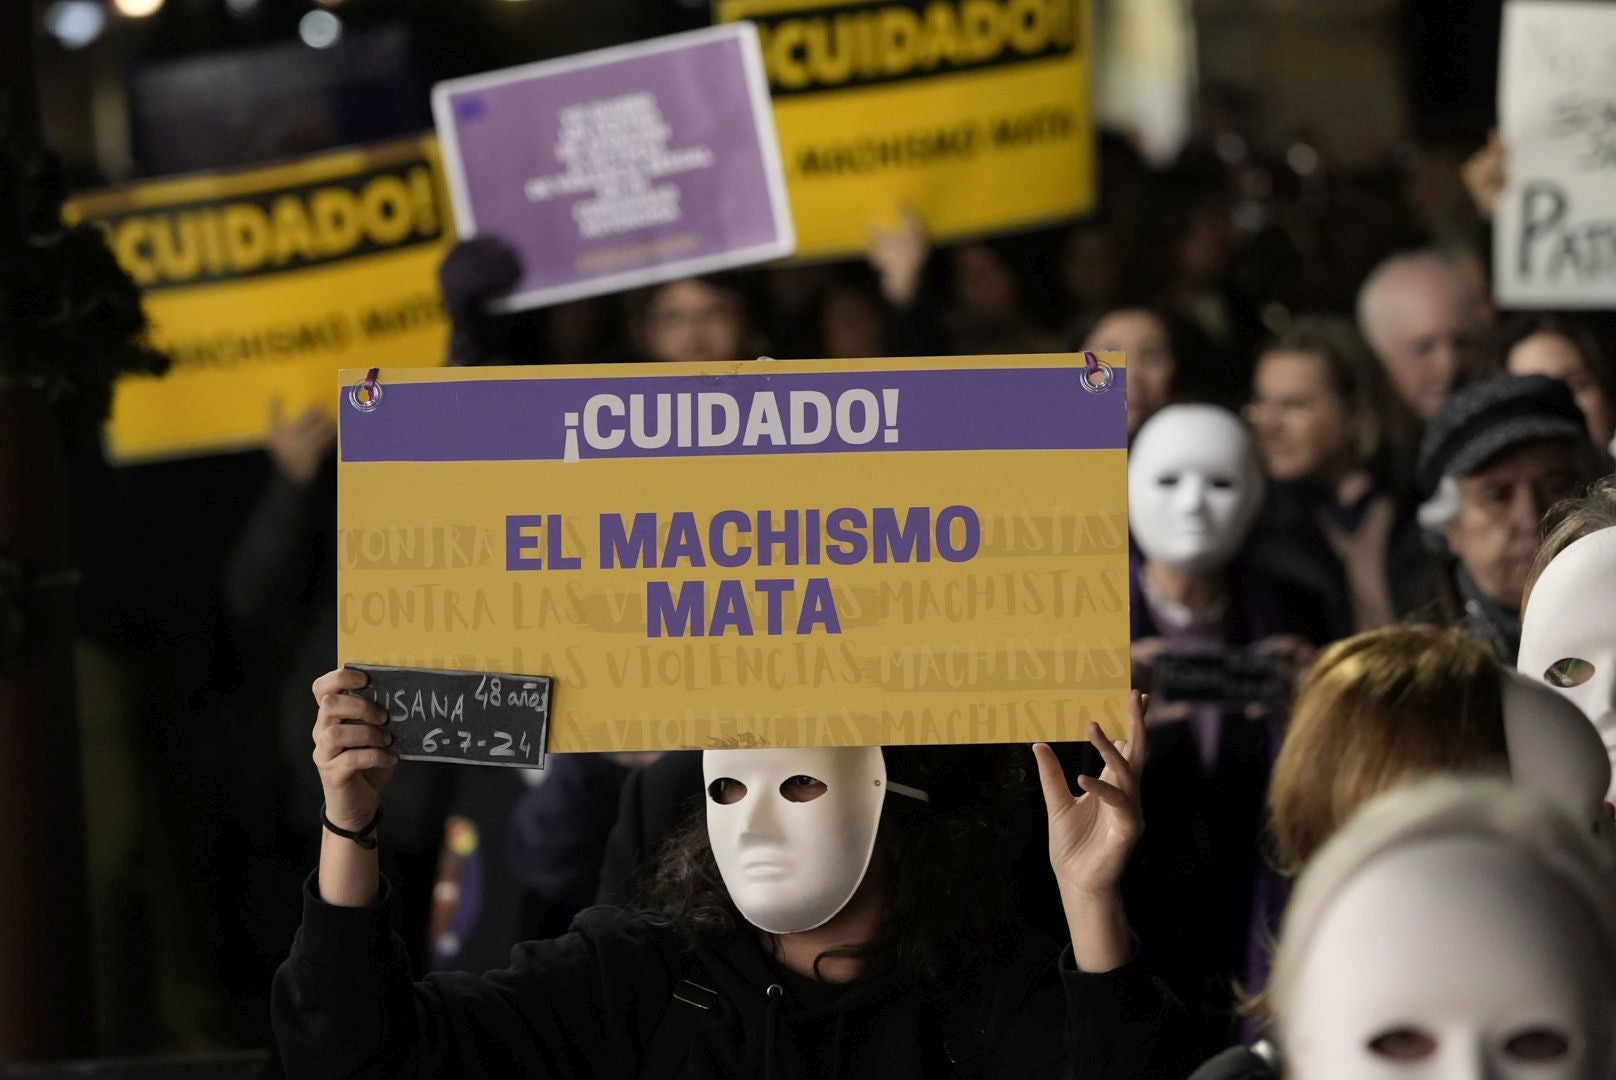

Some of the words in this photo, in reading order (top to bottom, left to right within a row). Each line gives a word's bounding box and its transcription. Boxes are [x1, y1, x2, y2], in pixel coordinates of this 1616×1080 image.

[760, 0, 1073, 89] CUIDADO!
[110, 168, 434, 285] CUIDADO!
[1515, 178, 1616, 283] PAT
[563, 388, 900, 463] ¡CUIDADO!
[340, 518, 496, 570] CONTRA
[505, 514, 581, 571] EL
[598, 504, 981, 570] MACHISMO
[339, 582, 497, 635] CONTRA
[512, 580, 588, 631] LAS
[880, 568, 1124, 624] MACHISTAS
[646, 577, 842, 638] MATA
[605, 638, 863, 692] VIOLENCIAS
[880, 634, 1125, 690] MACHISTAS
[372, 685, 464, 723] SANA
[474, 674, 502, 710] 48
[507, 683, 546, 713] años
